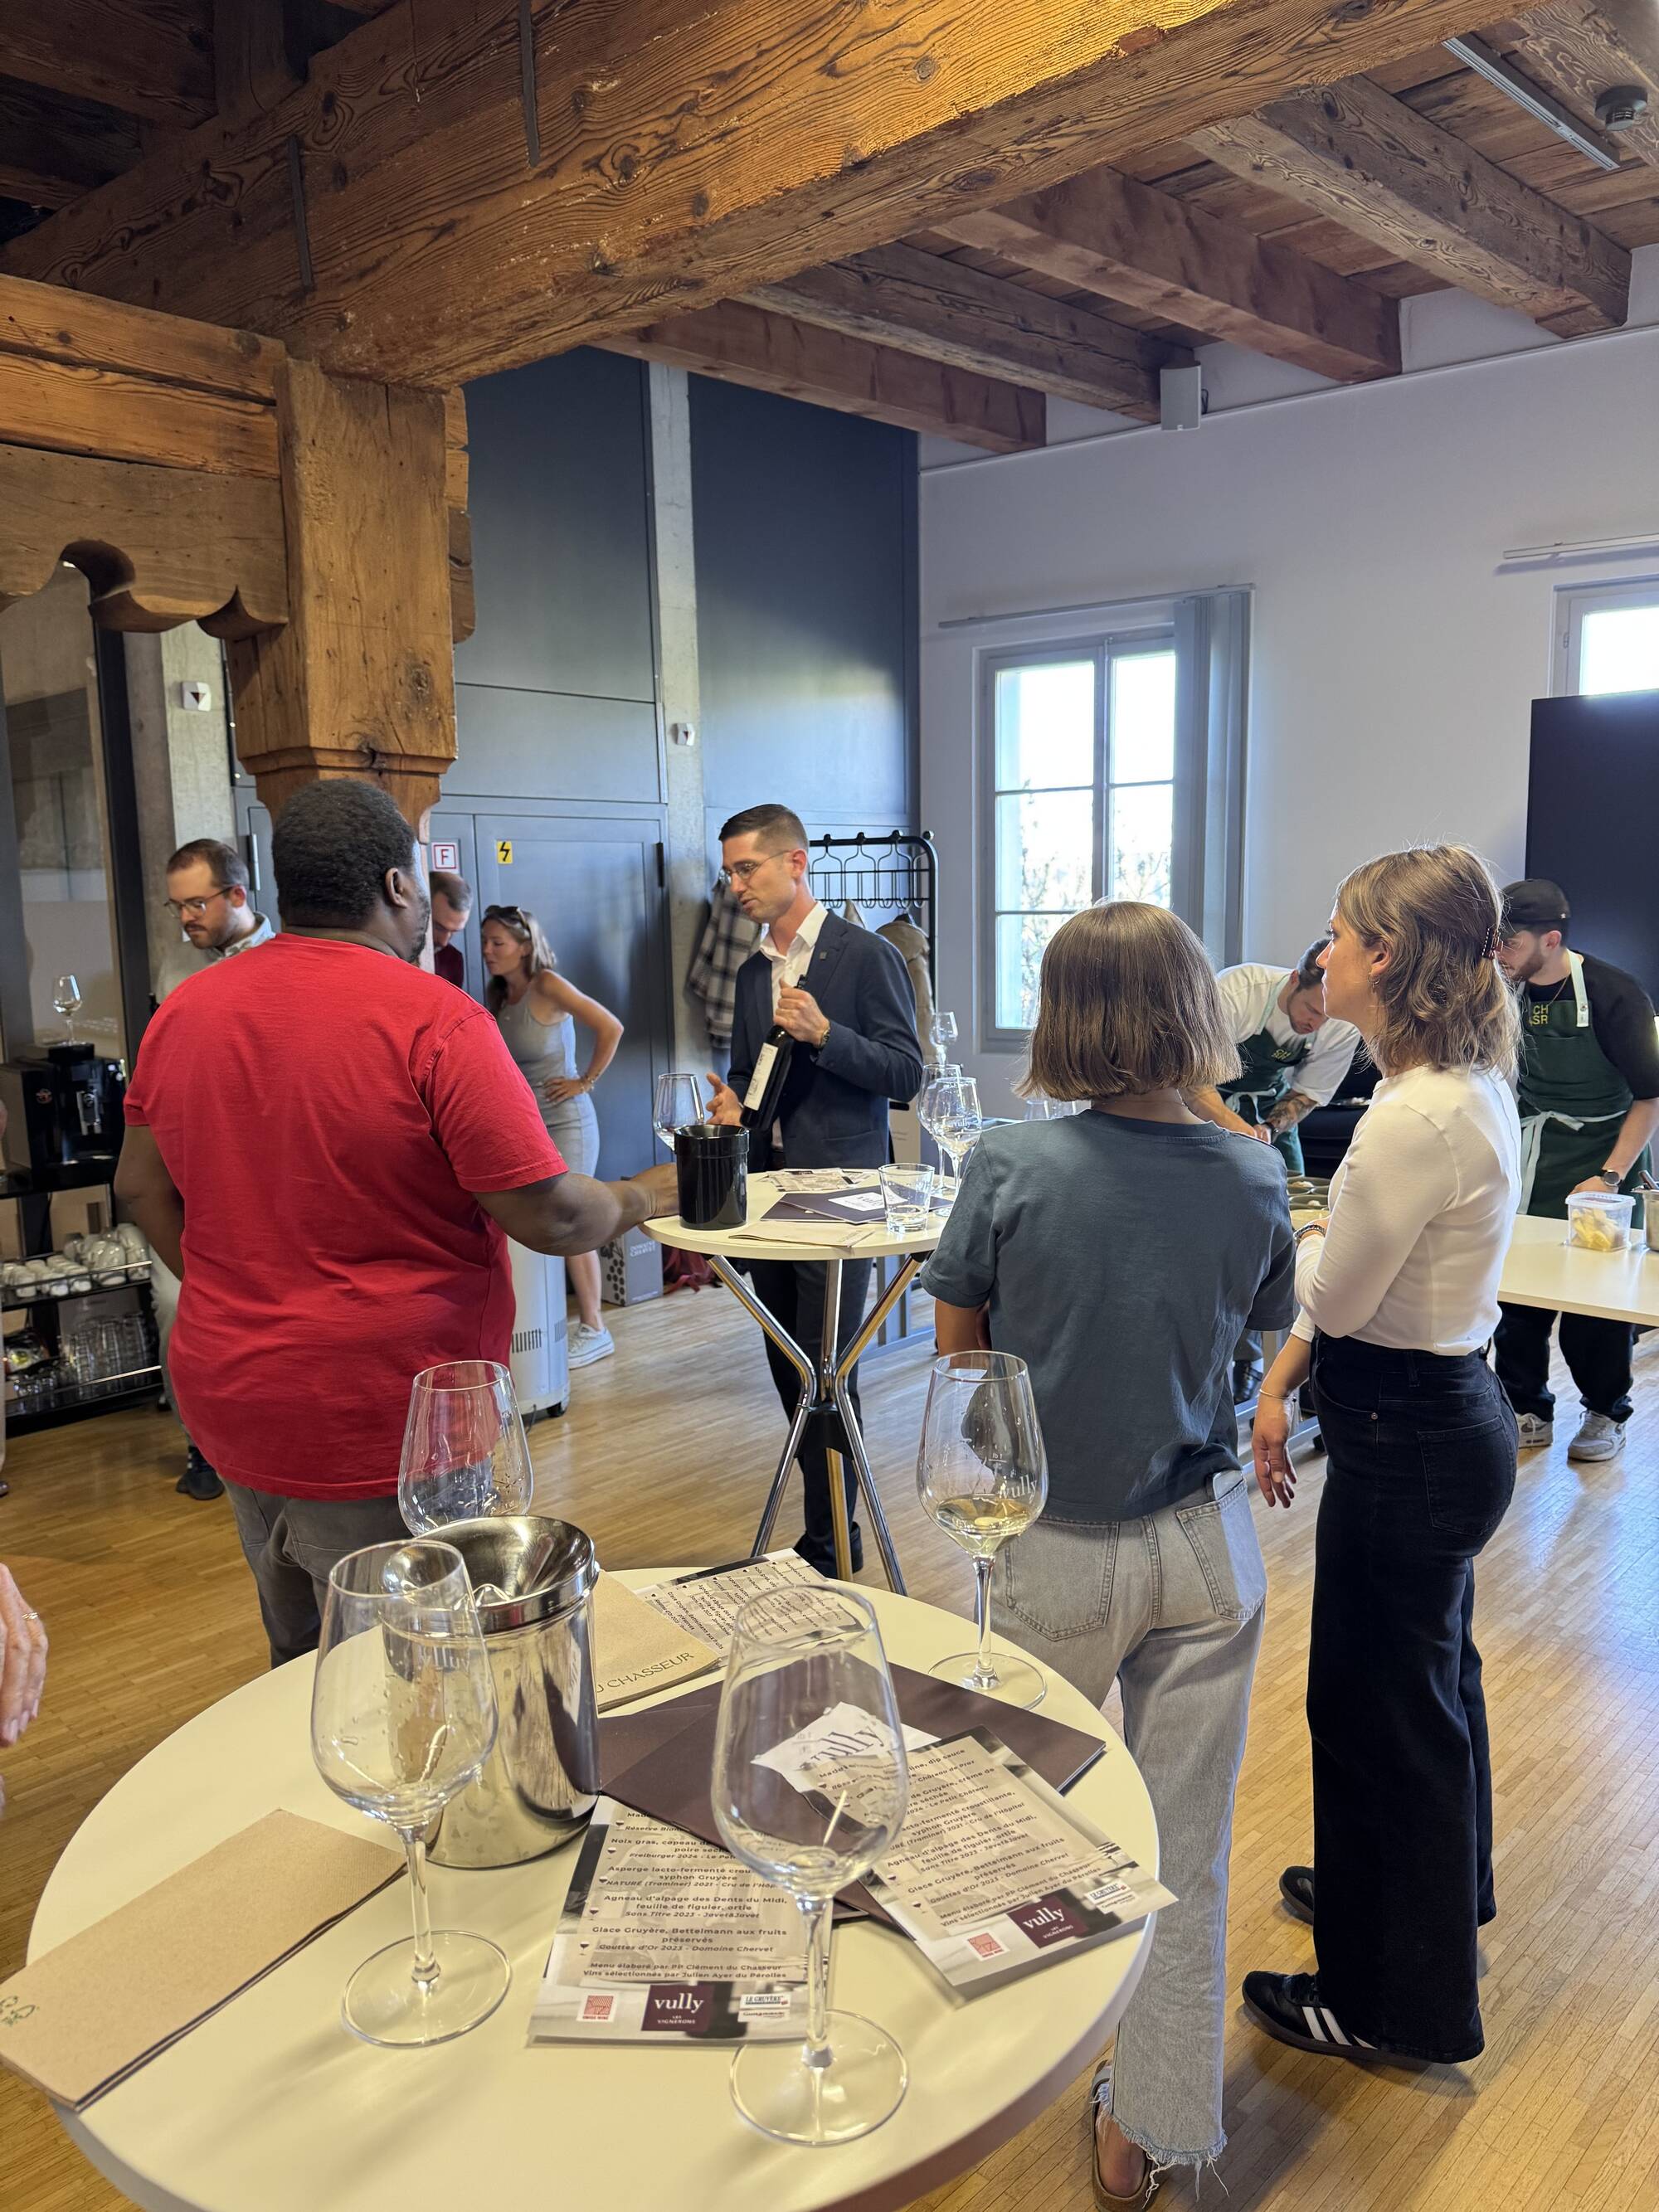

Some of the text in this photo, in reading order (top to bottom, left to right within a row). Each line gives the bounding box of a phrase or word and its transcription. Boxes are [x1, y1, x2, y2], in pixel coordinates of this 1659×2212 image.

[440, 848, 450, 865] F
[1533, 1004, 1549, 1015] CH
[607, 1652, 694, 1688] CHASSEUR
[887, 1854, 921, 1867] Agneau
[961, 1835, 977, 1844] des
[977, 1825, 1003, 1840] Dents
[1005, 1821, 1014, 1830] du
[608, 1866, 648, 1874] Asperge
[907, 1881, 933, 1894] Glace
[974, 1850, 1024, 1871] Bettelmann
[1024, 1845, 1041, 1854] aux
[1041, 1837, 1065, 1850] fruits
[645, 1895, 689, 1903] d'alpage
[687, 1903, 724, 1912] figuier,
[1023, 1908, 1064, 1928] vully
[624, 1927, 669, 1935] Gruyère,
[654, 1993, 703, 2014] vully
